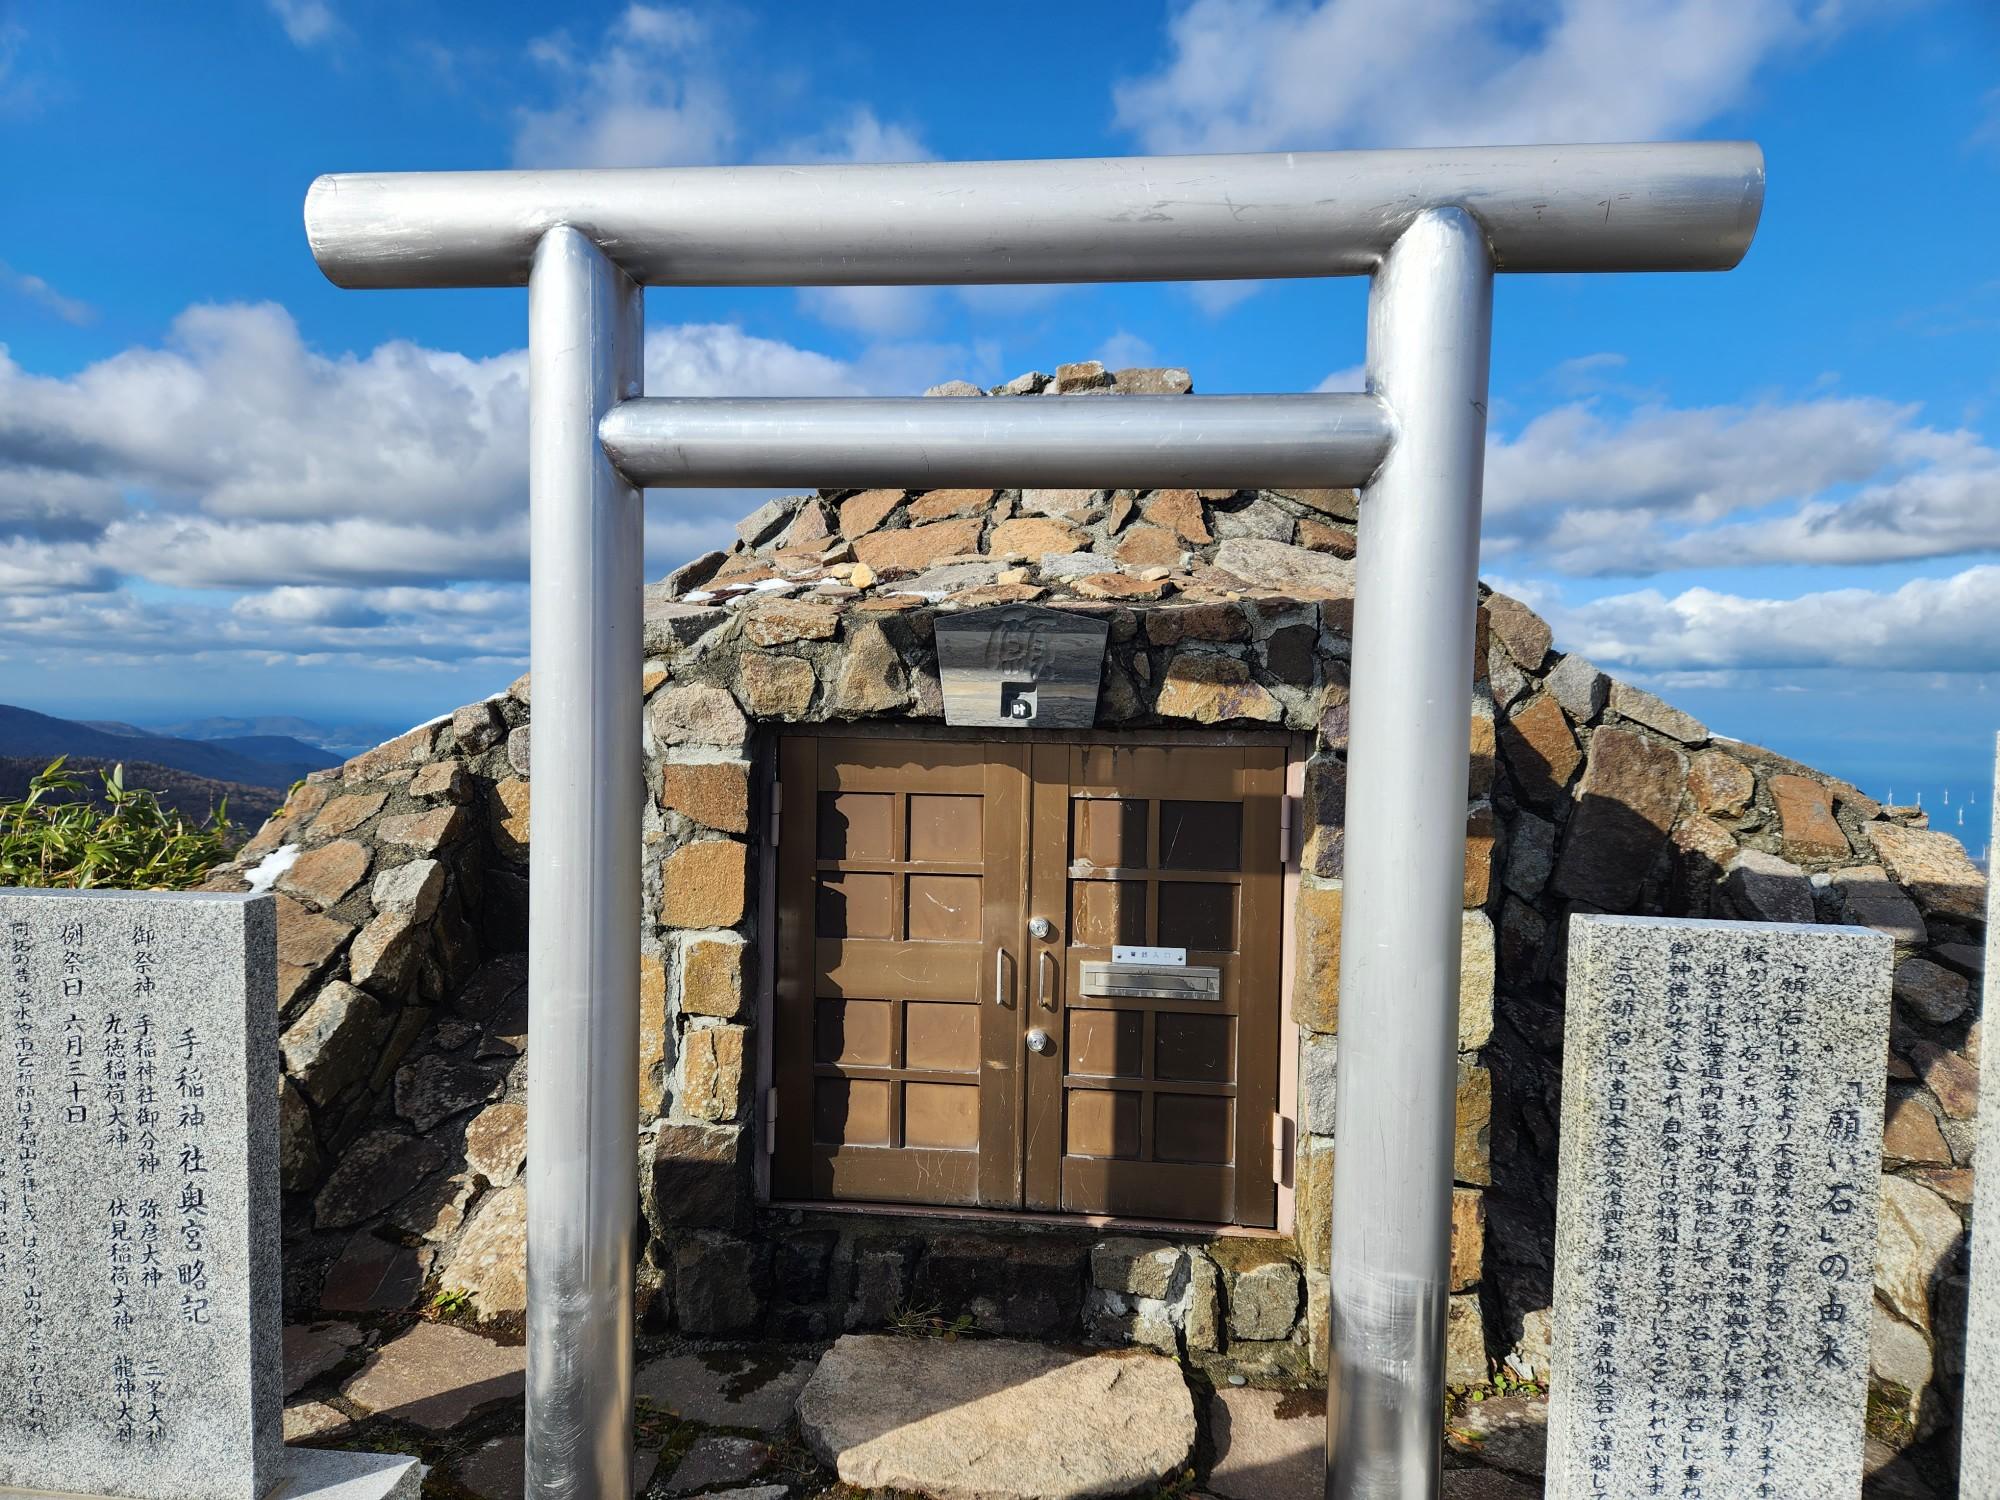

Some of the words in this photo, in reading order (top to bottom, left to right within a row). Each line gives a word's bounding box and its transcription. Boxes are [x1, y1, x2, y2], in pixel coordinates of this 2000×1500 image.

[61, 922, 84, 996] 例祭日
[131, 925, 156, 998] 御祭神
[64, 1013, 87, 1124] 六月三十日
[132, 1014, 160, 1174] 手稲神社御分神
[174, 1027, 210, 1324] 手稲神社奥宮略記
[107, 1199, 134, 1332] 伏見稲荷大神
[138, 1200, 163, 1289] 弥彦大神
